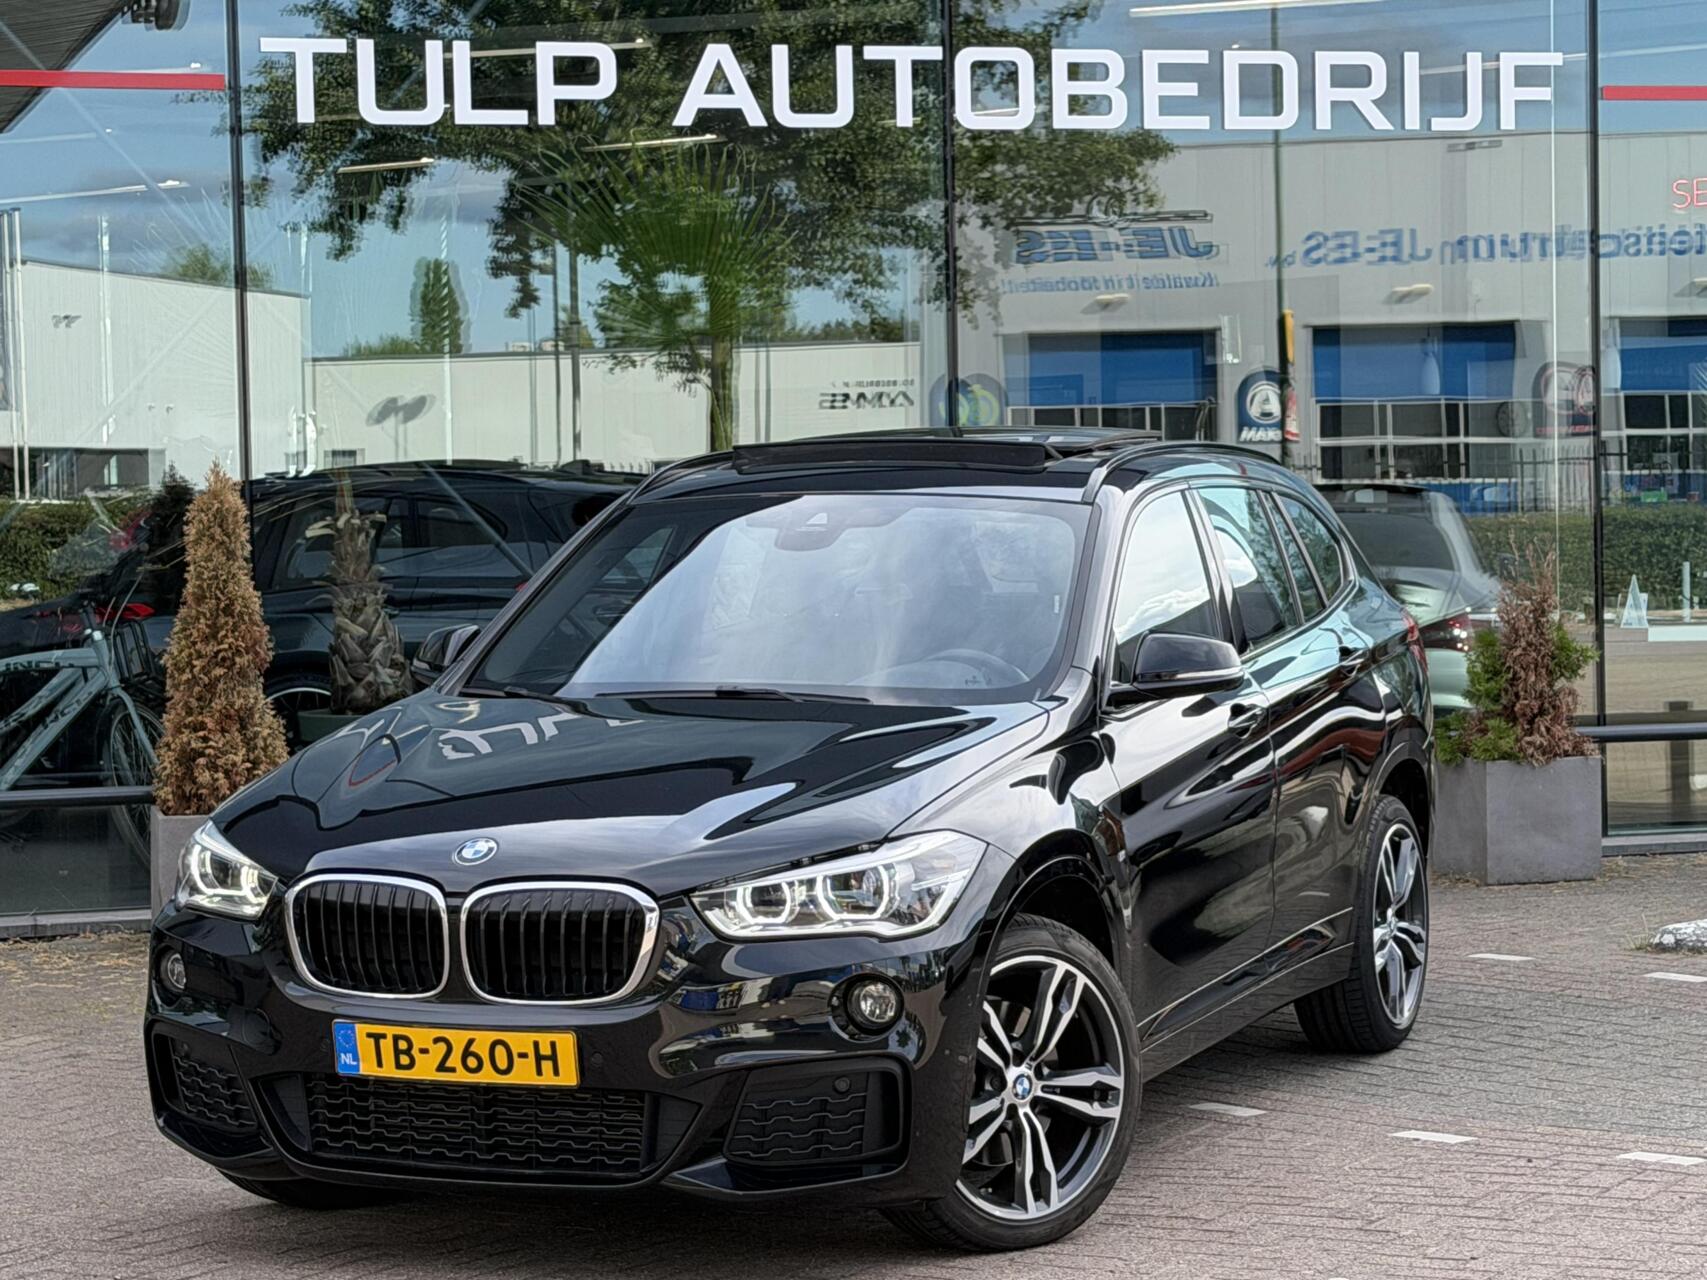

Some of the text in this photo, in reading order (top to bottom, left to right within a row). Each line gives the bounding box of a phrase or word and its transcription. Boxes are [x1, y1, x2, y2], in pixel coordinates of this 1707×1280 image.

[258, 36, 1564, 132] TULP AUTOBEDRIJF
[340, 1031, 561, 1077] NL TB-260-H
